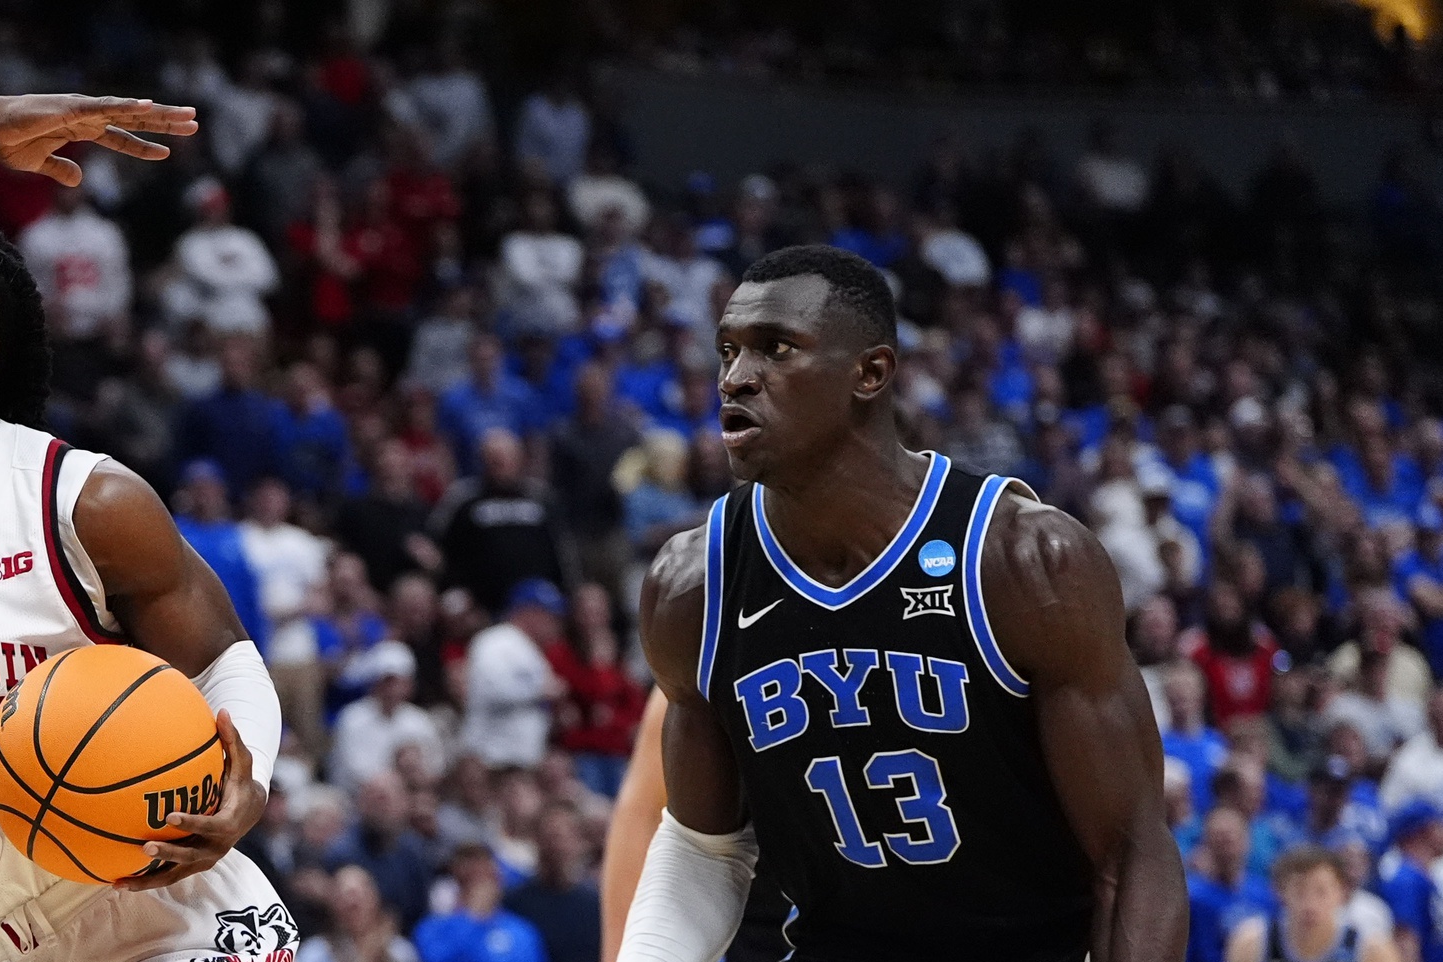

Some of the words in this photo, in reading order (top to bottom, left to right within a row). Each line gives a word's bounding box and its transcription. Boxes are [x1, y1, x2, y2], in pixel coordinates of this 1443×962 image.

[923, 556, 954, 568] NCAA
[733, 648, 970, 753] BYU
[804, 748, 962, 869] 13
